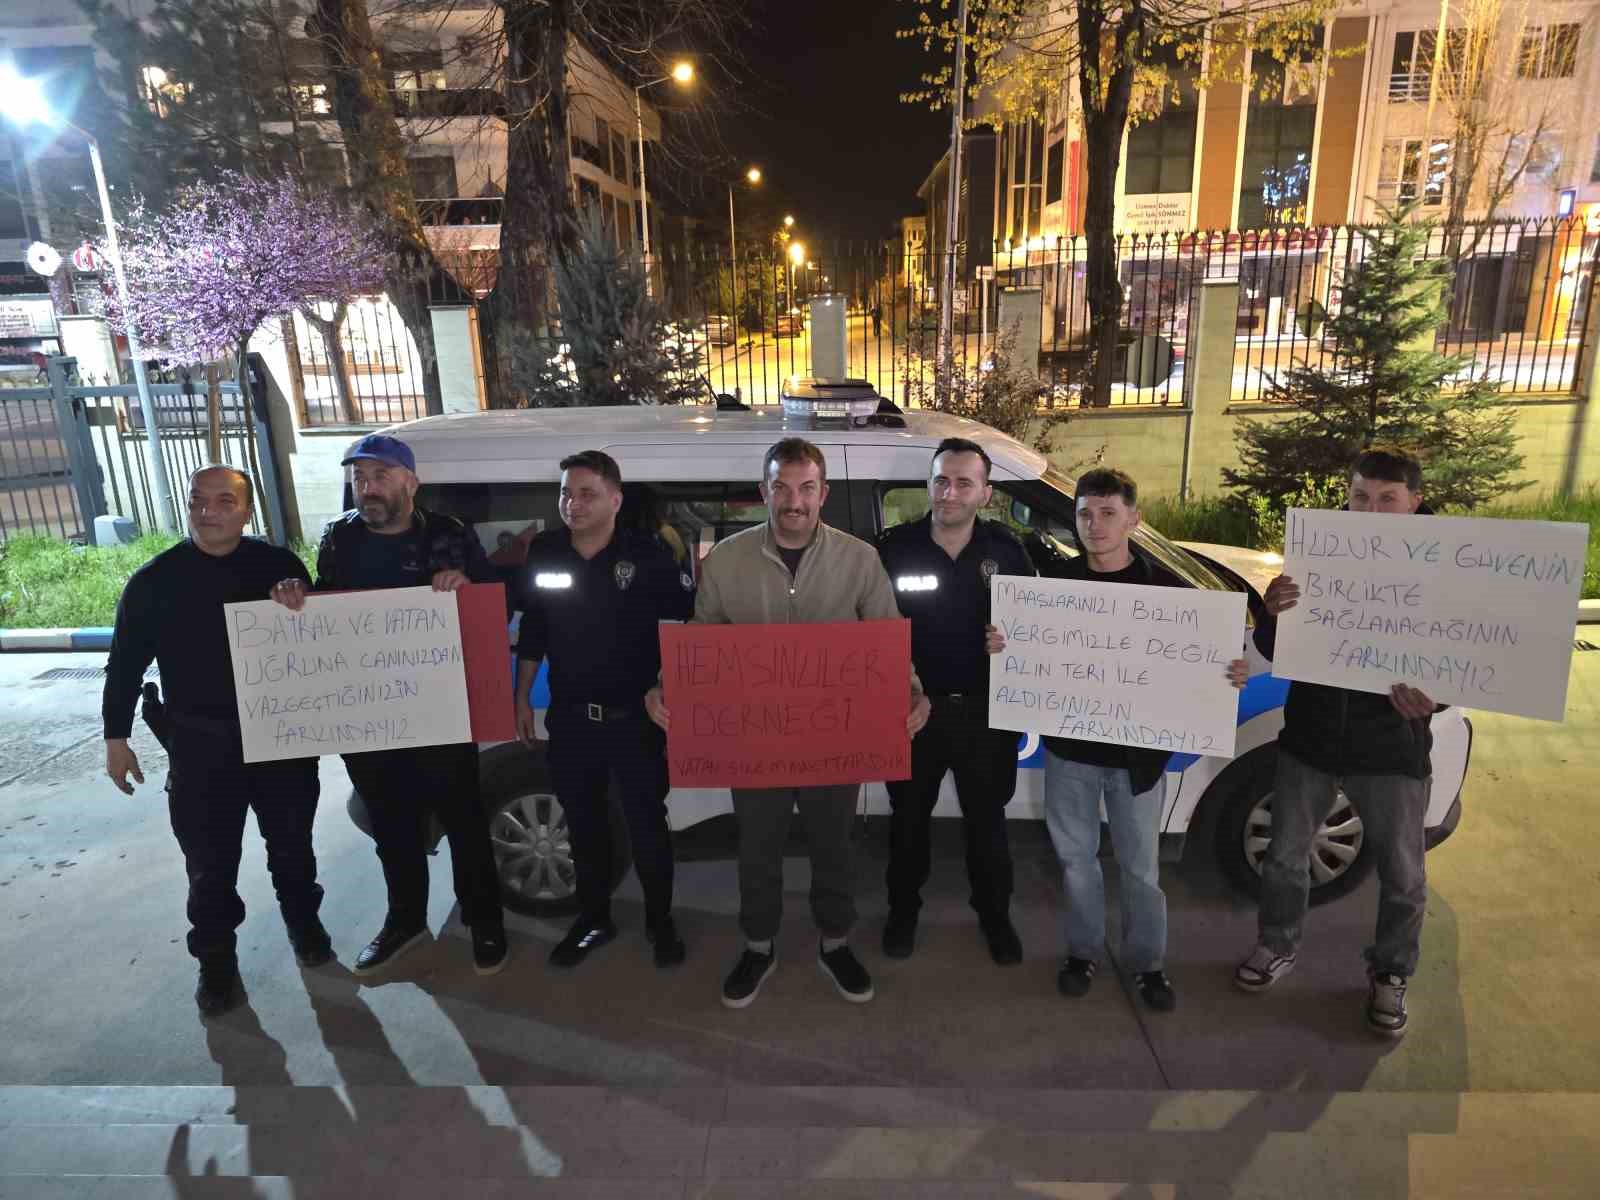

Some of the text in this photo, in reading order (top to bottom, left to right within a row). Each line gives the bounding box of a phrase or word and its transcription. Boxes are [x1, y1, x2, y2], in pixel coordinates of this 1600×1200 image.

[1290, 512, 1393, 560] HUZUR
[1402, 539, 1441, 563] VE
[348, 612, 375, 636] VE
[1005, 655, 1052, 677] ALIN
